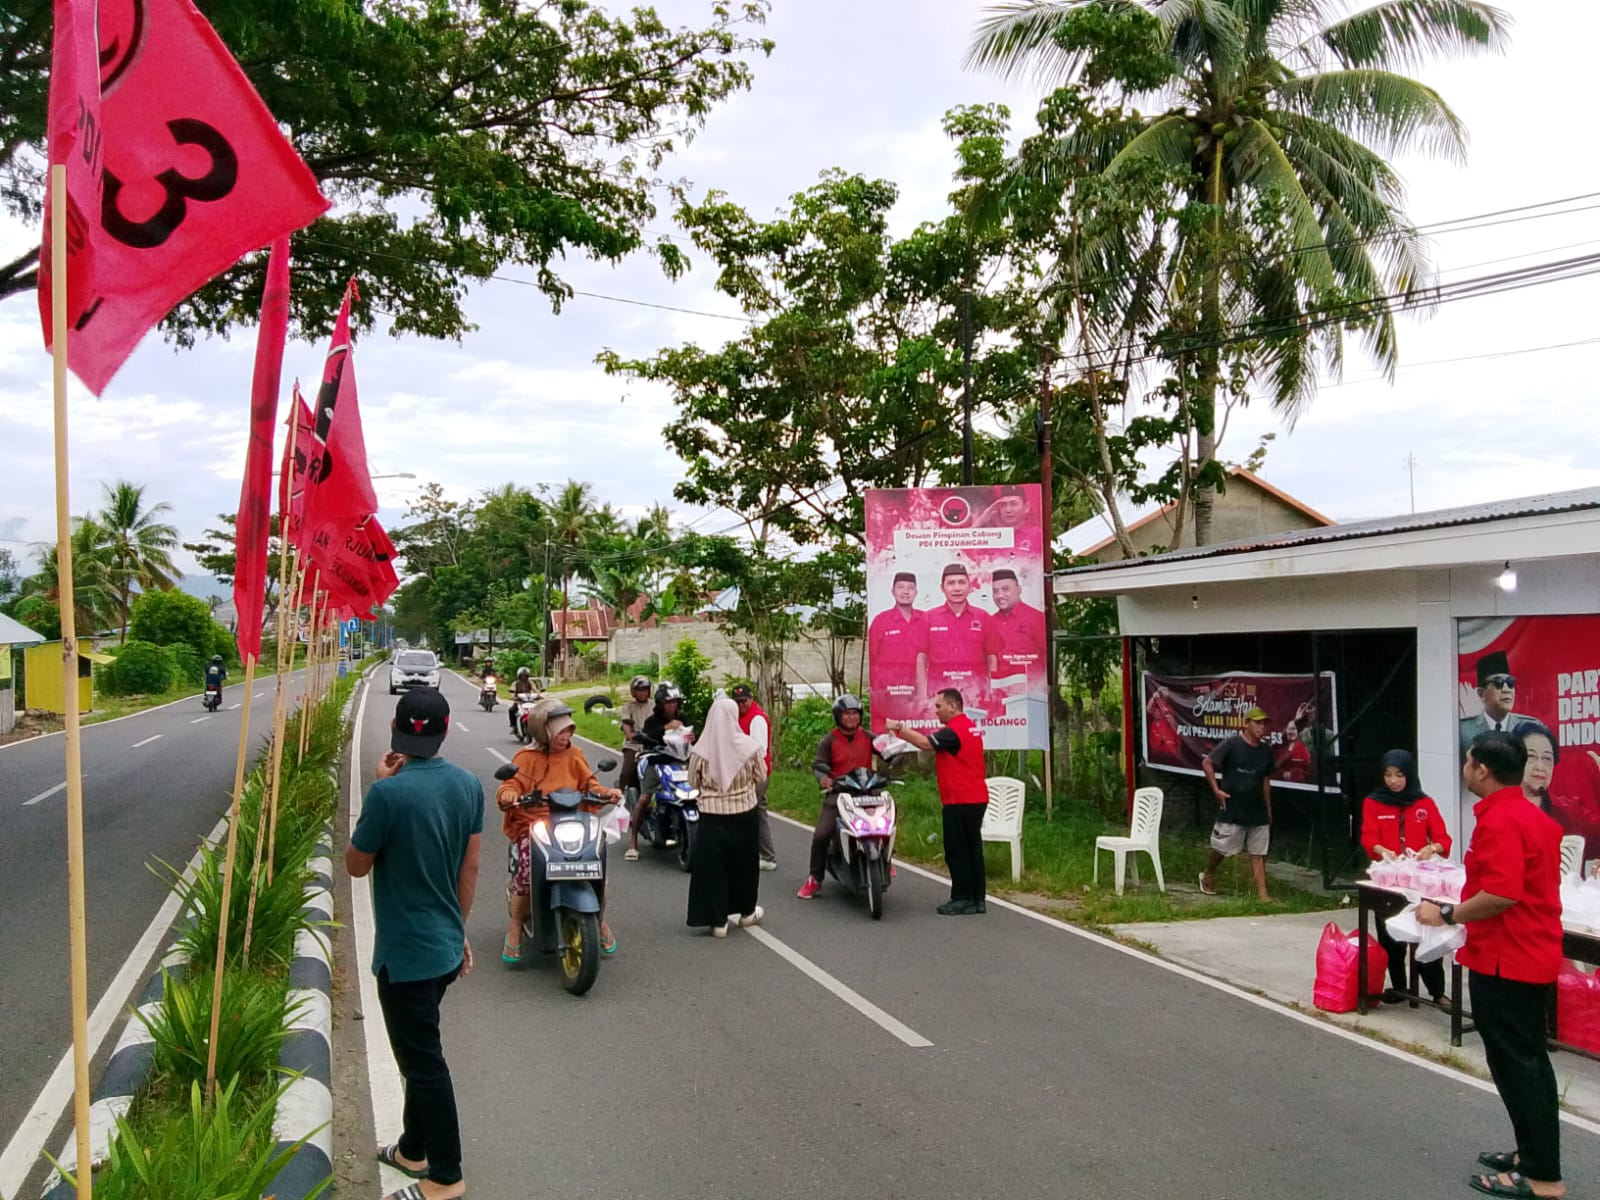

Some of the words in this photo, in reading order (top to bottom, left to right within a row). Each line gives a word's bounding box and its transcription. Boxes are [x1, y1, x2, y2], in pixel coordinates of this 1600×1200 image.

[102, 117, 239, 249] 3
[933, 531, 970, 540] Pimpinan
[972, 530, 1002, 539] Cabang
[934, 540, 989, 548] PERJUANGAN
[1558, 669, 1600, 696] PAR
[980, 718, 1027, 727] BOLANGO
[1177, 725, 1191, 737] PDI
